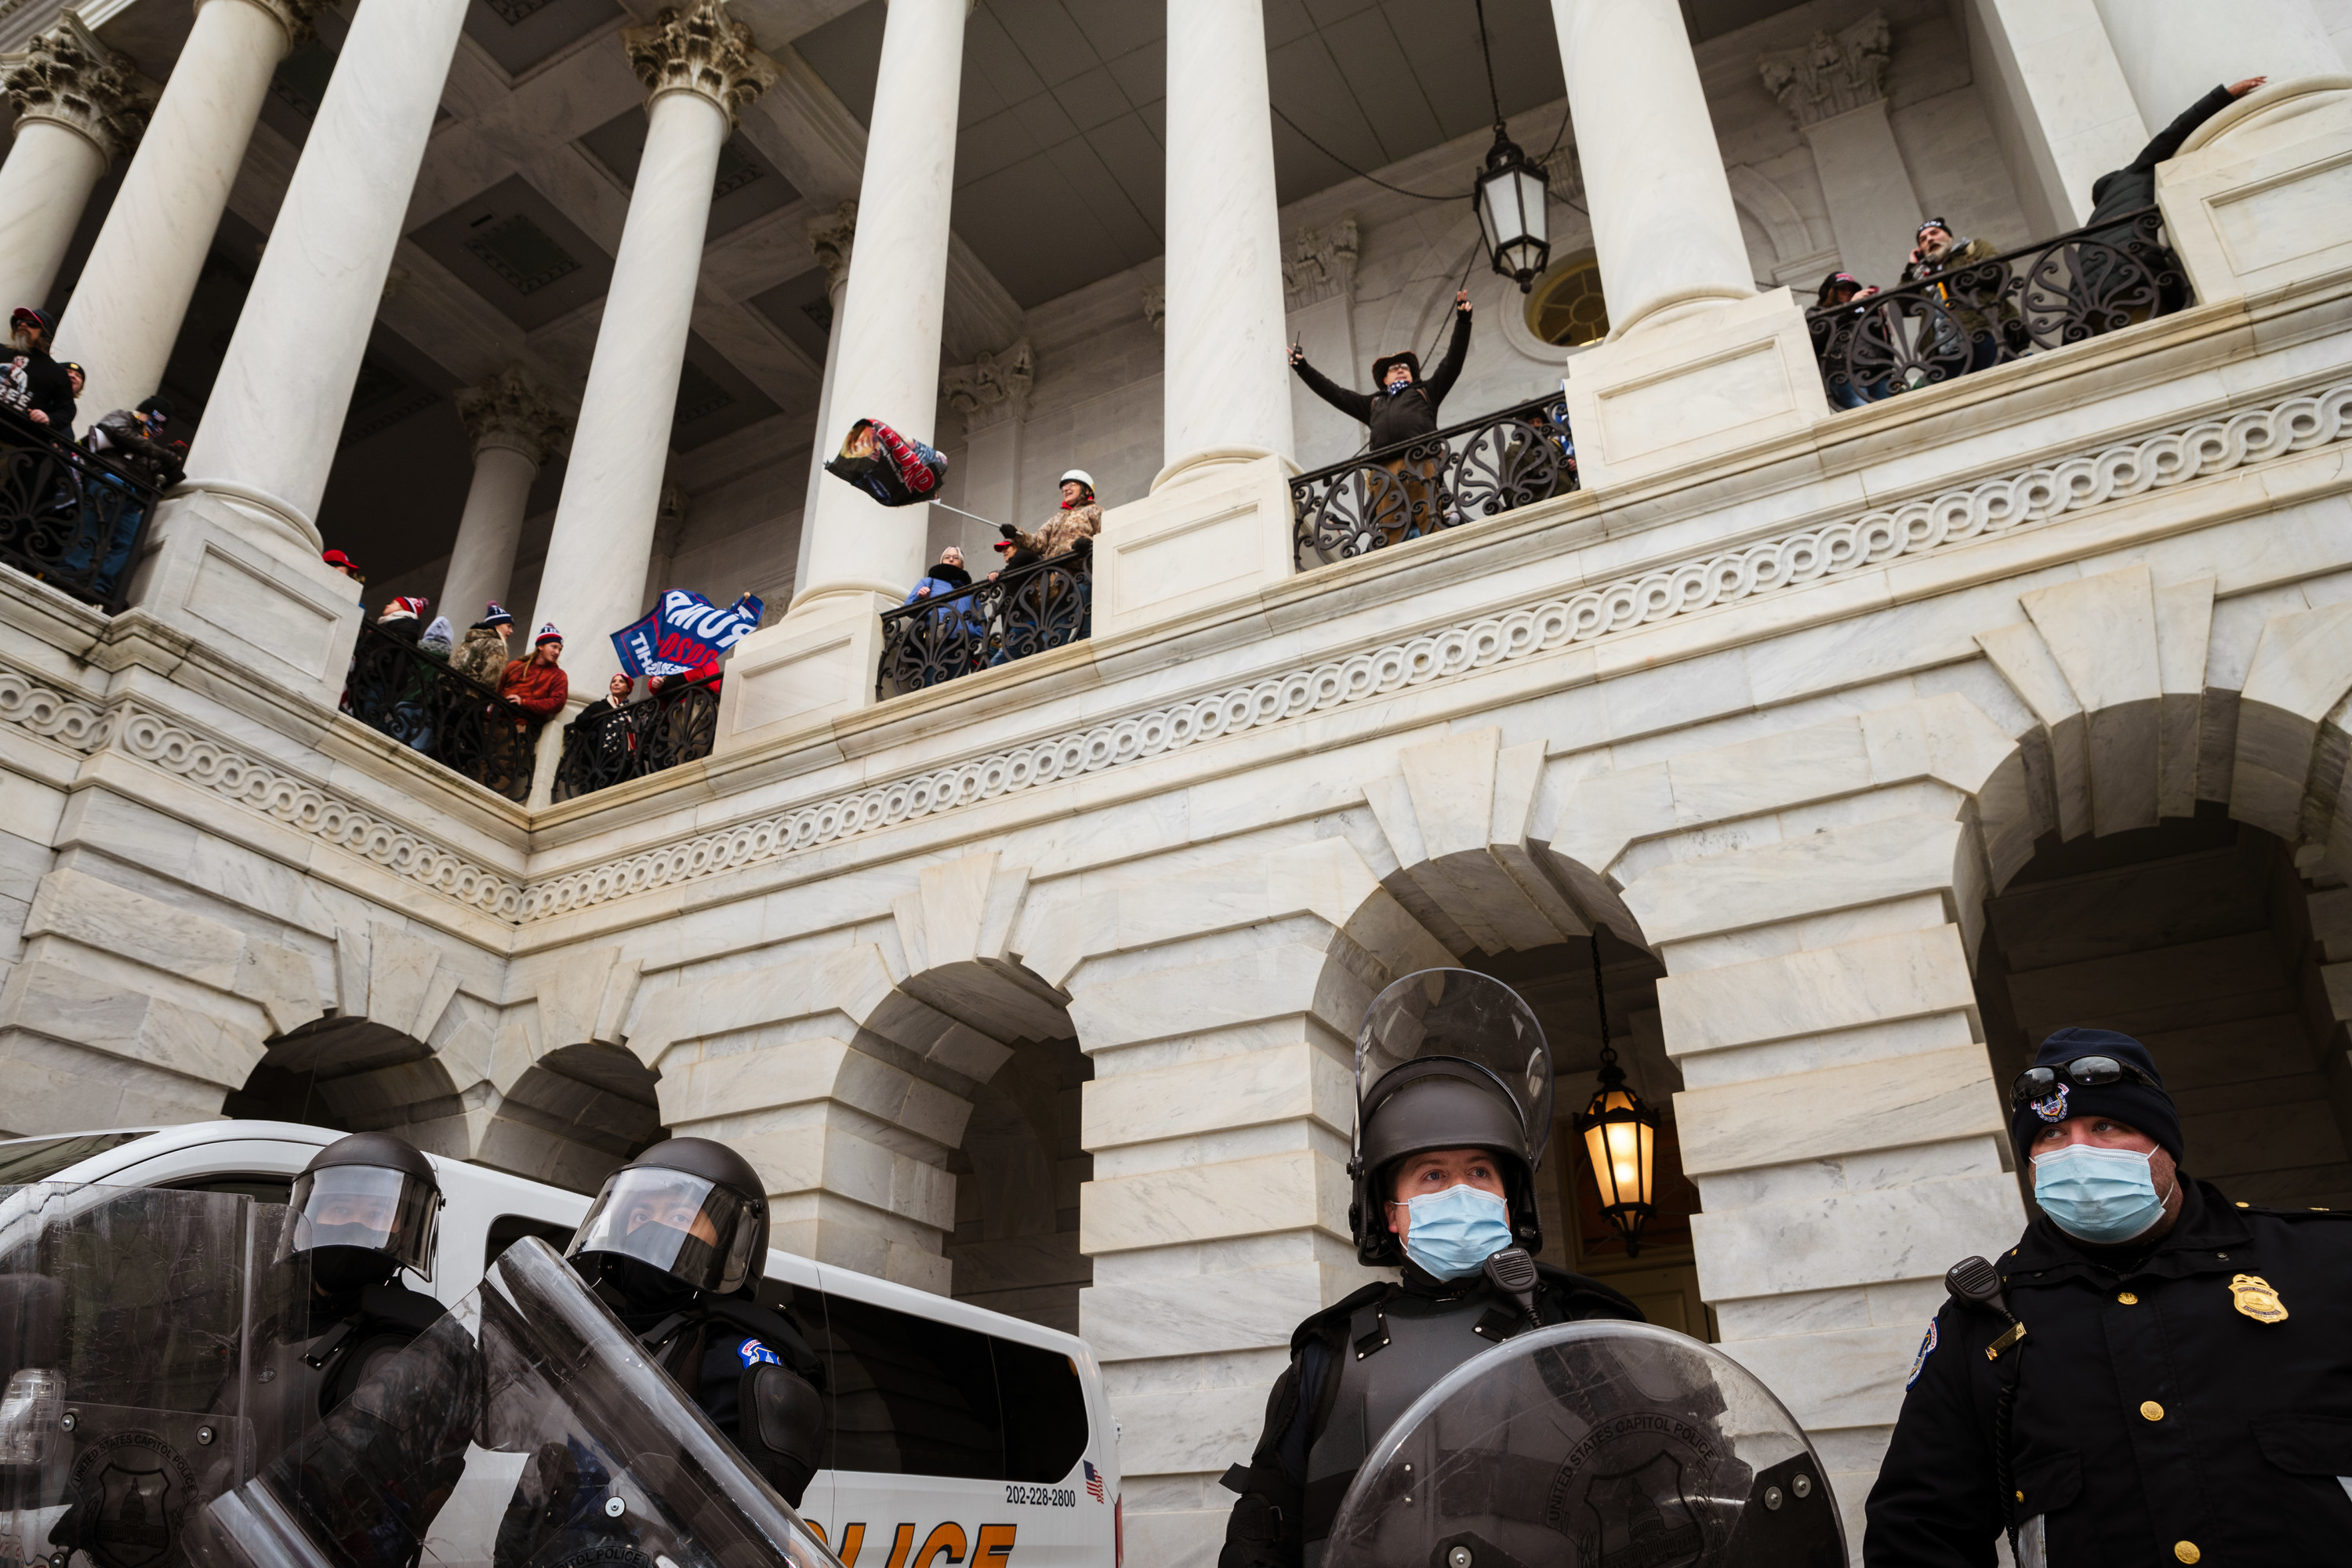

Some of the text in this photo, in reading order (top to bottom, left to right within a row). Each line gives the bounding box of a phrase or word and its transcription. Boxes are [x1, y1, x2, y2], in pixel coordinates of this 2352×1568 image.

[872, 421, 935, 493] RUMP
[74, 1435, 194, 1493] UNITED STATES CAPITOL POLICE
[1548, 1416, 1715, 1521] UNITED STATES CAPITOL POLICE
[1006, 1485, 1076, 1508] 202-228-2800
[597, 1548, 643, 1566] POLICE
